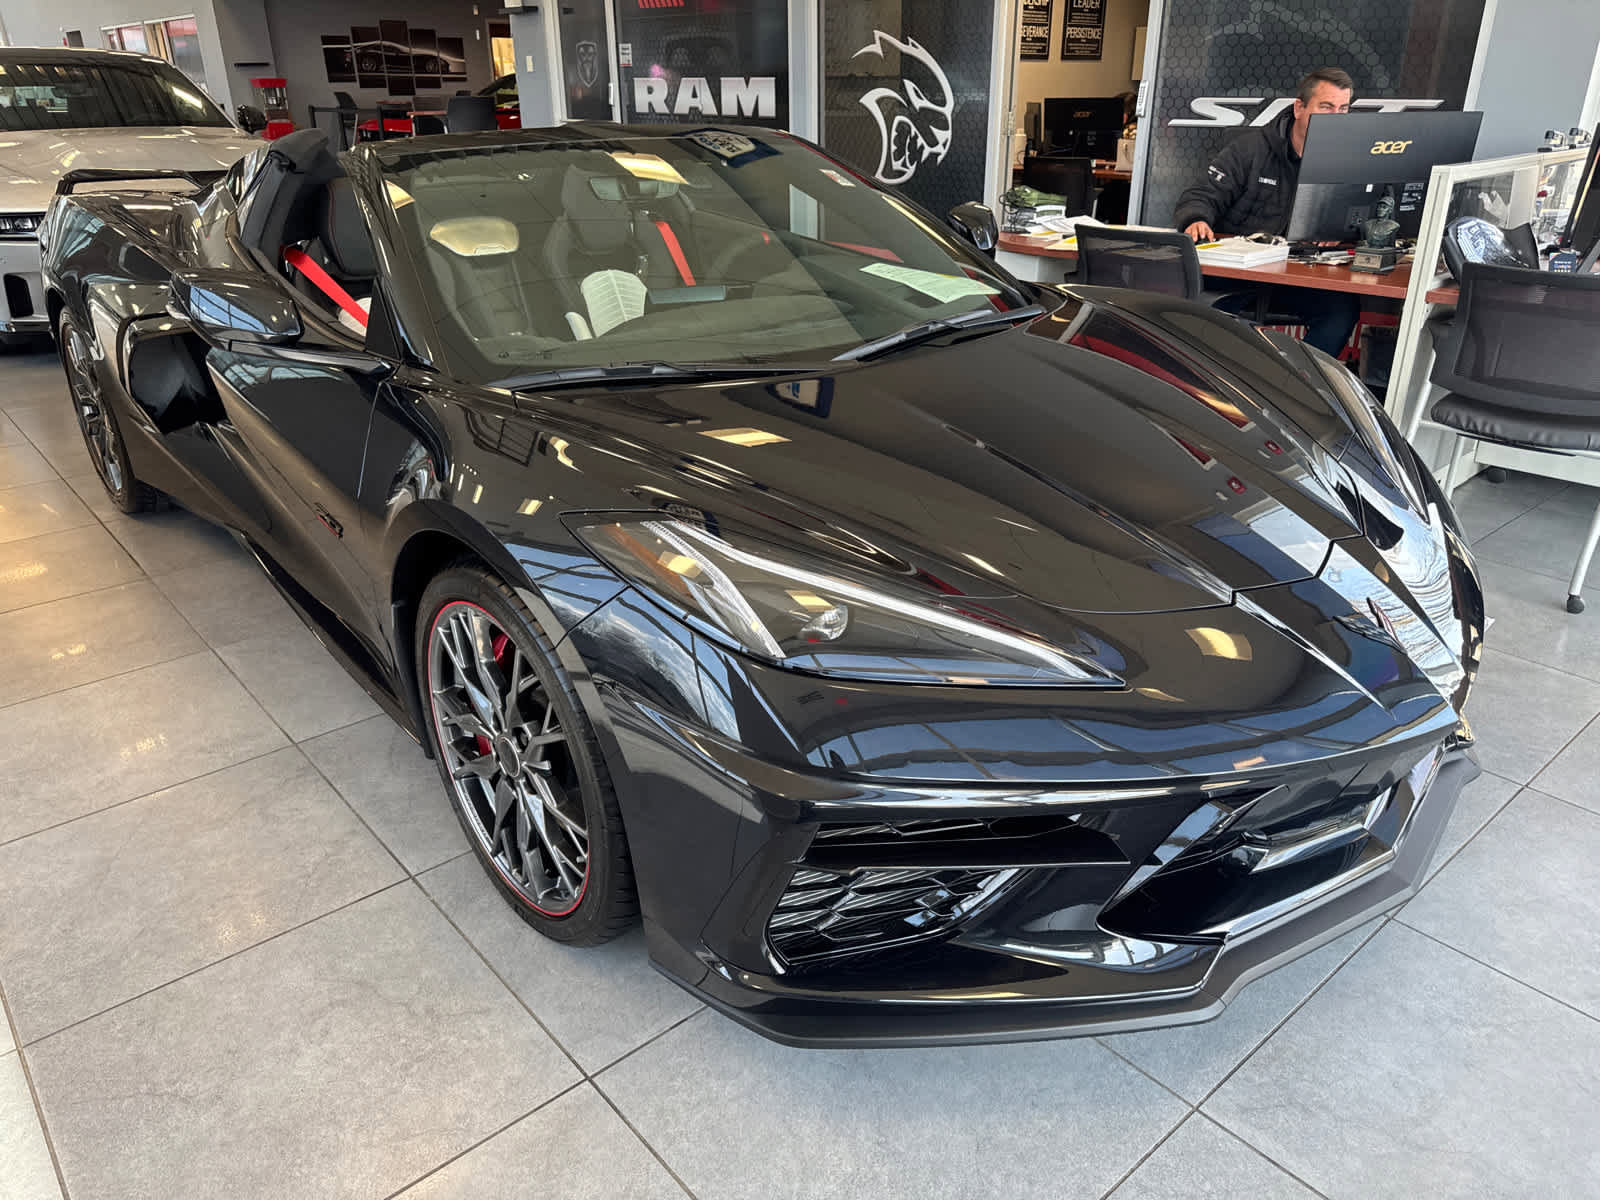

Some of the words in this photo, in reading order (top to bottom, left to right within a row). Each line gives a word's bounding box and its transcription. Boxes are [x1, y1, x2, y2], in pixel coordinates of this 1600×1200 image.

[1066, 27, 1102, 39] PERSISTENCE
[633, 77, 776, 117] RAM
[1370, 140, 1413, 154] acer
